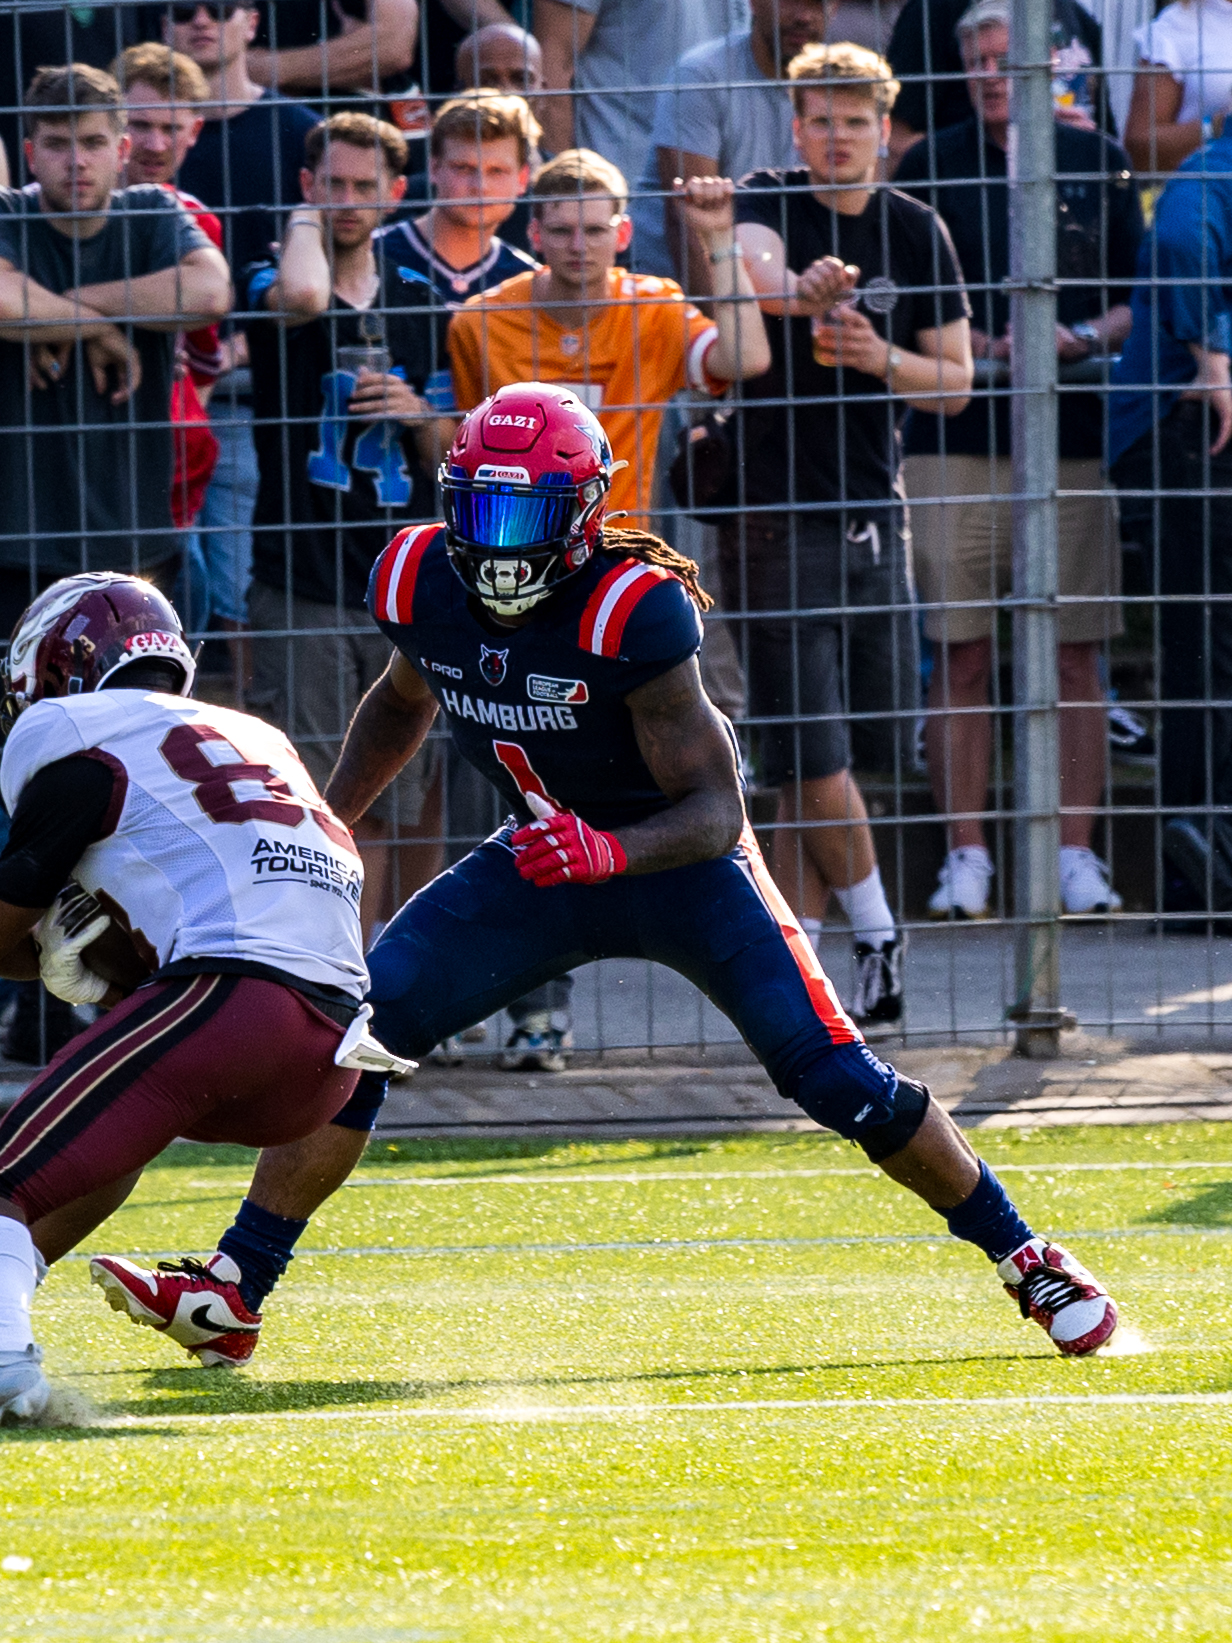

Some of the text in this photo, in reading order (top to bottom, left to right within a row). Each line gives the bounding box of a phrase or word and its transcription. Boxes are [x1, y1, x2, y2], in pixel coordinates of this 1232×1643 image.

[489, 414, 536, 430] GAZI
[132, 632, 179, 651] GAZ
[431, 662, 463, 680] PRO
[441, 687, 578, 731] HAMBURG
[252, 838, 363, 887] AMERICA
[251, 856, 361, 904] TOURISTE
